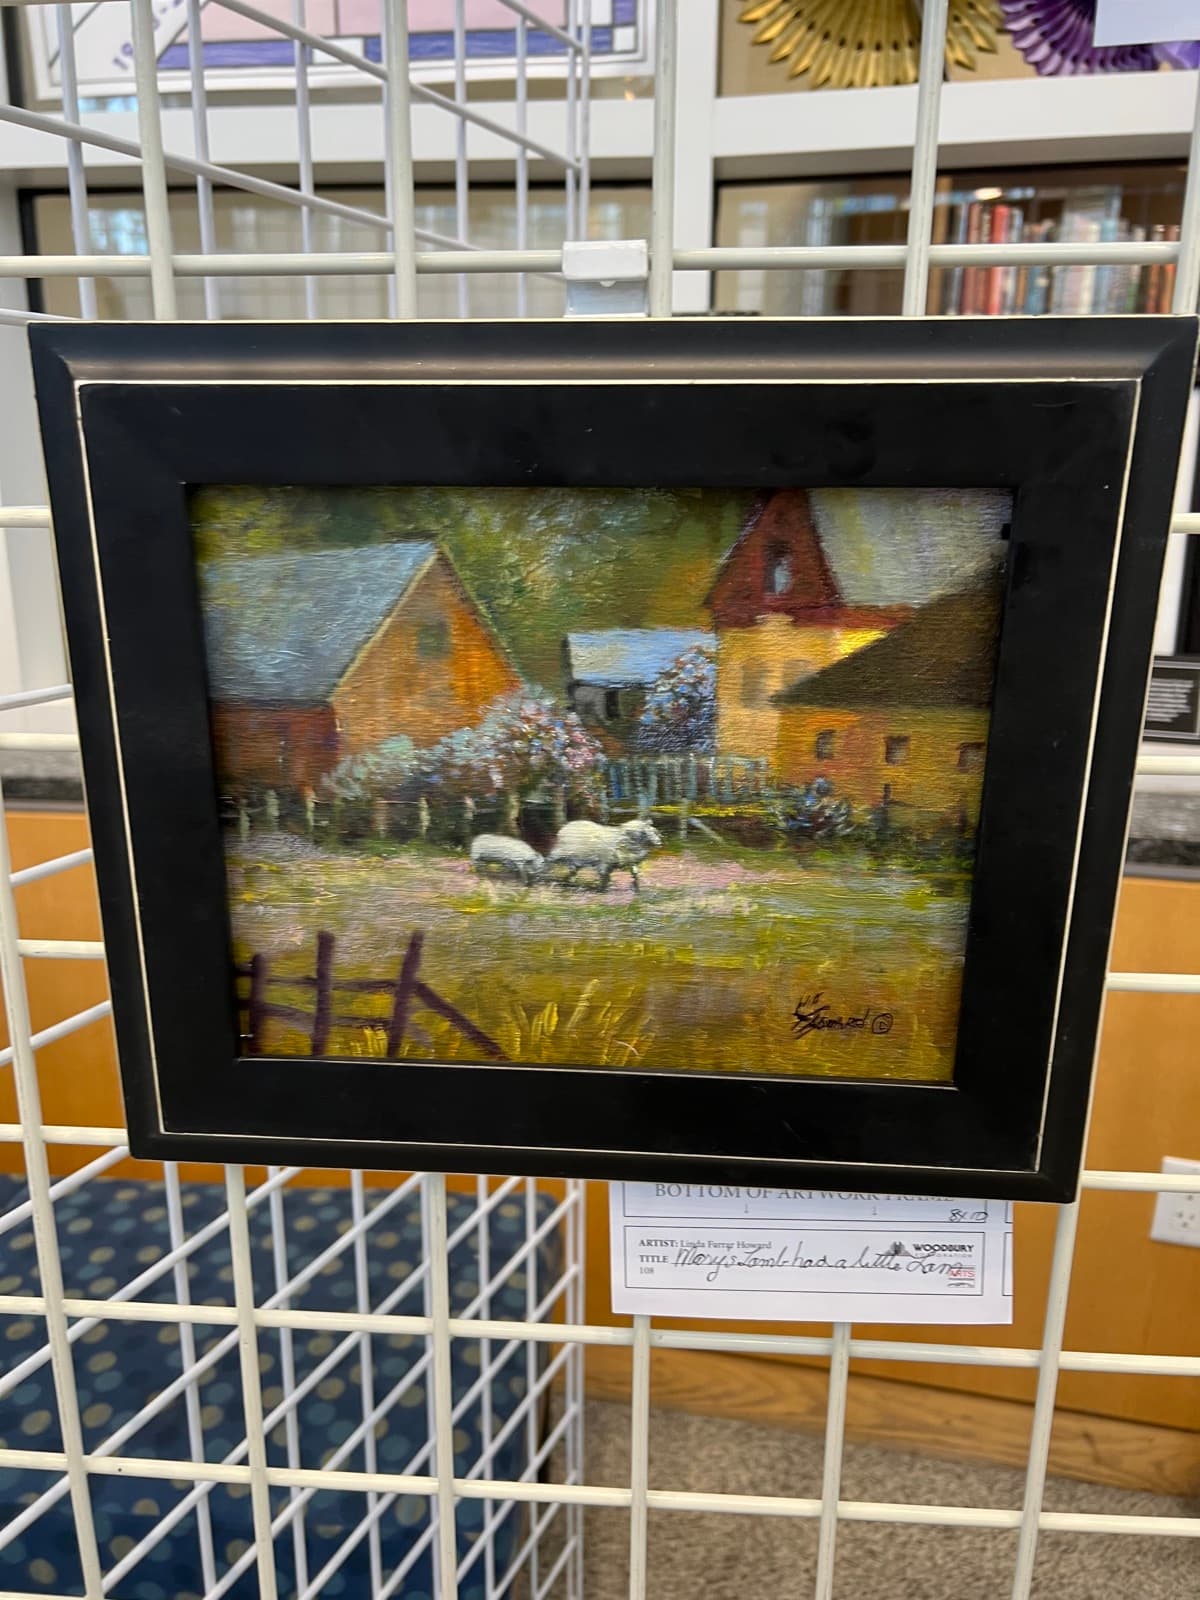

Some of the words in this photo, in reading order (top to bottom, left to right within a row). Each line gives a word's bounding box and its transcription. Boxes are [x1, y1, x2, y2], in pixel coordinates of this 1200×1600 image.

[654, 1183, 741, 1198] BOTTOM
[639, 1239, 678, 1248] ARTIST:
[912, 1243, 975, 1253] WOODBURY
[639, 1254, 669, 1264] TITLE
[639, 1266, 655, 1275] 108
